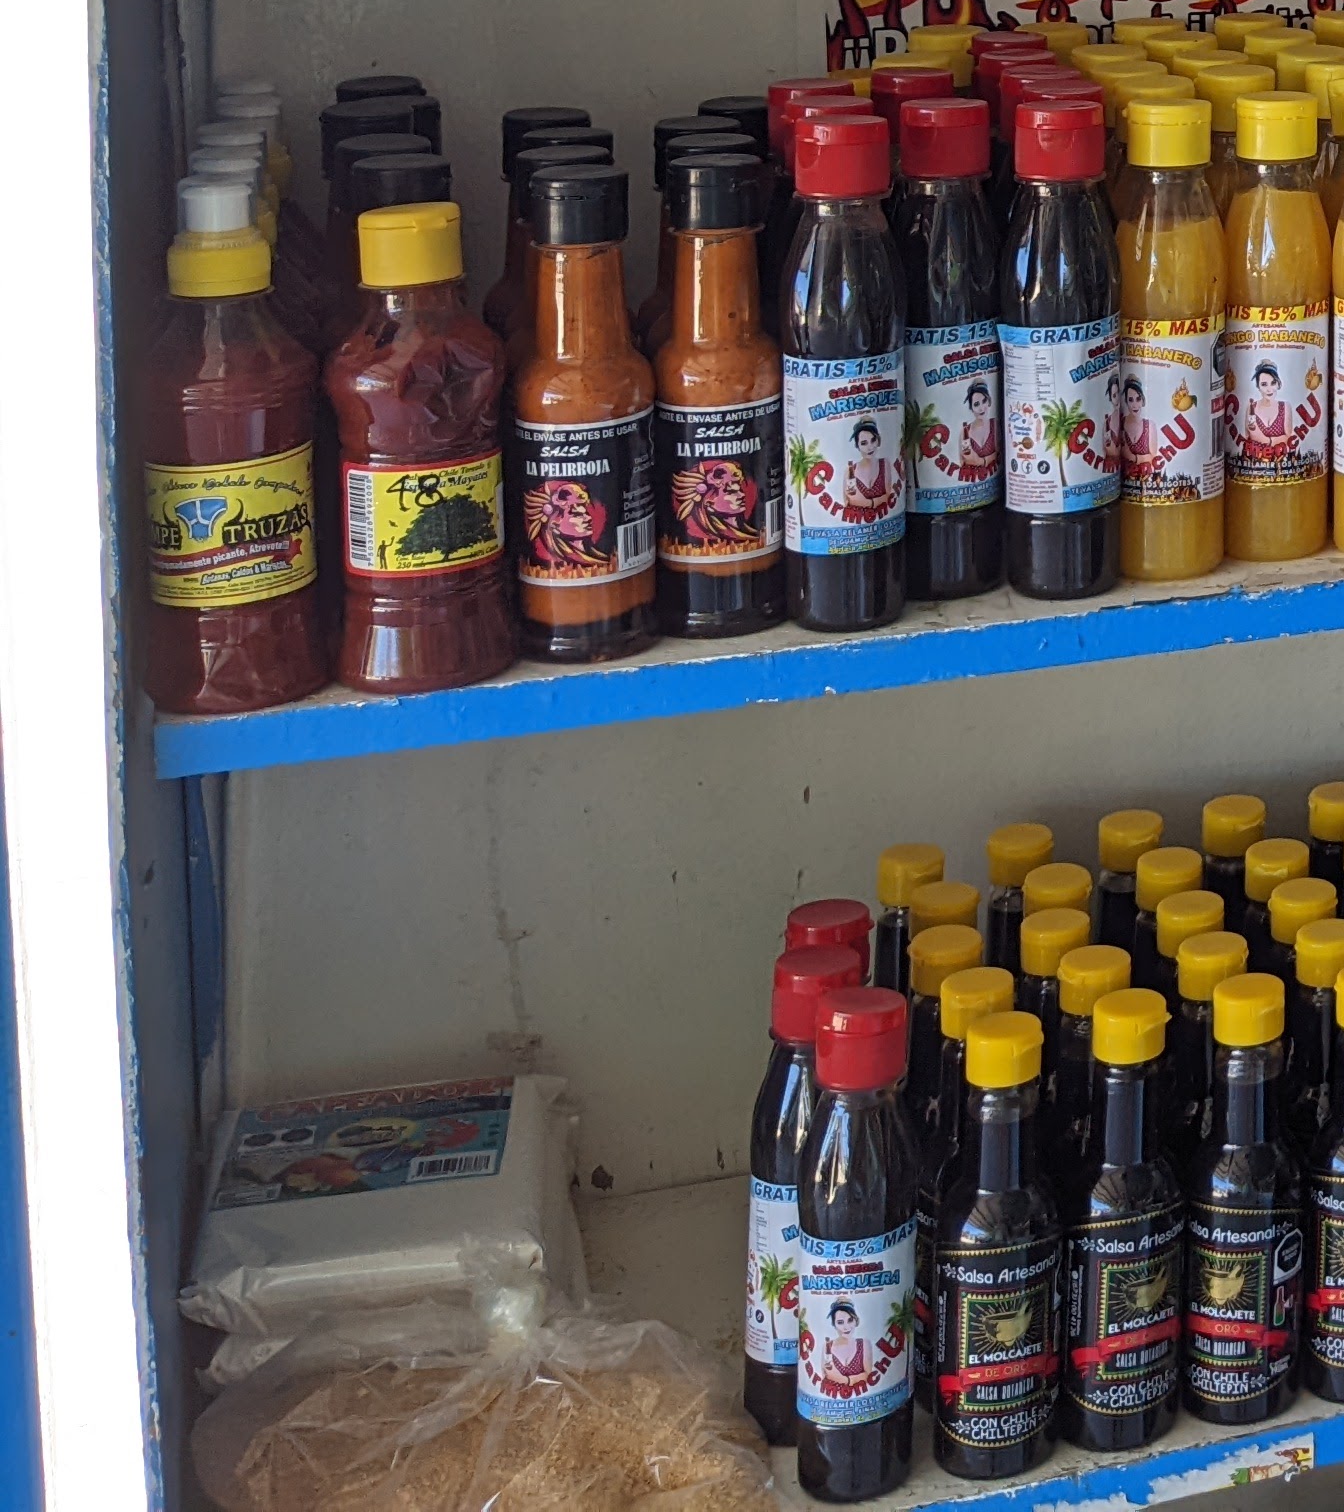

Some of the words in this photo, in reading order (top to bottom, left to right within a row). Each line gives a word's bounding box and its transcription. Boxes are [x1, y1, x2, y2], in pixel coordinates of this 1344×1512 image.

[1258, 307, 1297, 322] 15%
[1029, 326, 1101, 344] GRATIS
[1125, 322, 1160, 337] 15%
[784, 360, 846, 379] GRATIS
[855, 356, 893, 375] 15%
[569, 429, 601, 442] ANTES
[603, 426, 614, 437] DE
[616, 422, 638, 436] USAR
[695, 424, 744, 439] SALSA
[540, 445, 590, 458] SALSA
[677, 441, 691, 457] LA
[694, 437, 762, 458] PELIRROJA
[526, 460, 538, 477] LA
[540, 458, 610, 477] PELIRROJA
[386, 474, 444, 512] 48
[224, 504, 308, 543] TRUZAS
[831, 1240, 875, 1259] 15%
[957, 1266, 994, 1285] Salsa
[998, 1254, 1057, 1285] Artesanal
[1325, 1276, 1335, 1286] EL
[969, 1353, 982, 1364] EL
[984, 1342, 1042, 1364] MOLCAJETE
[1004, 1407, 1038, 1427] CHILE
